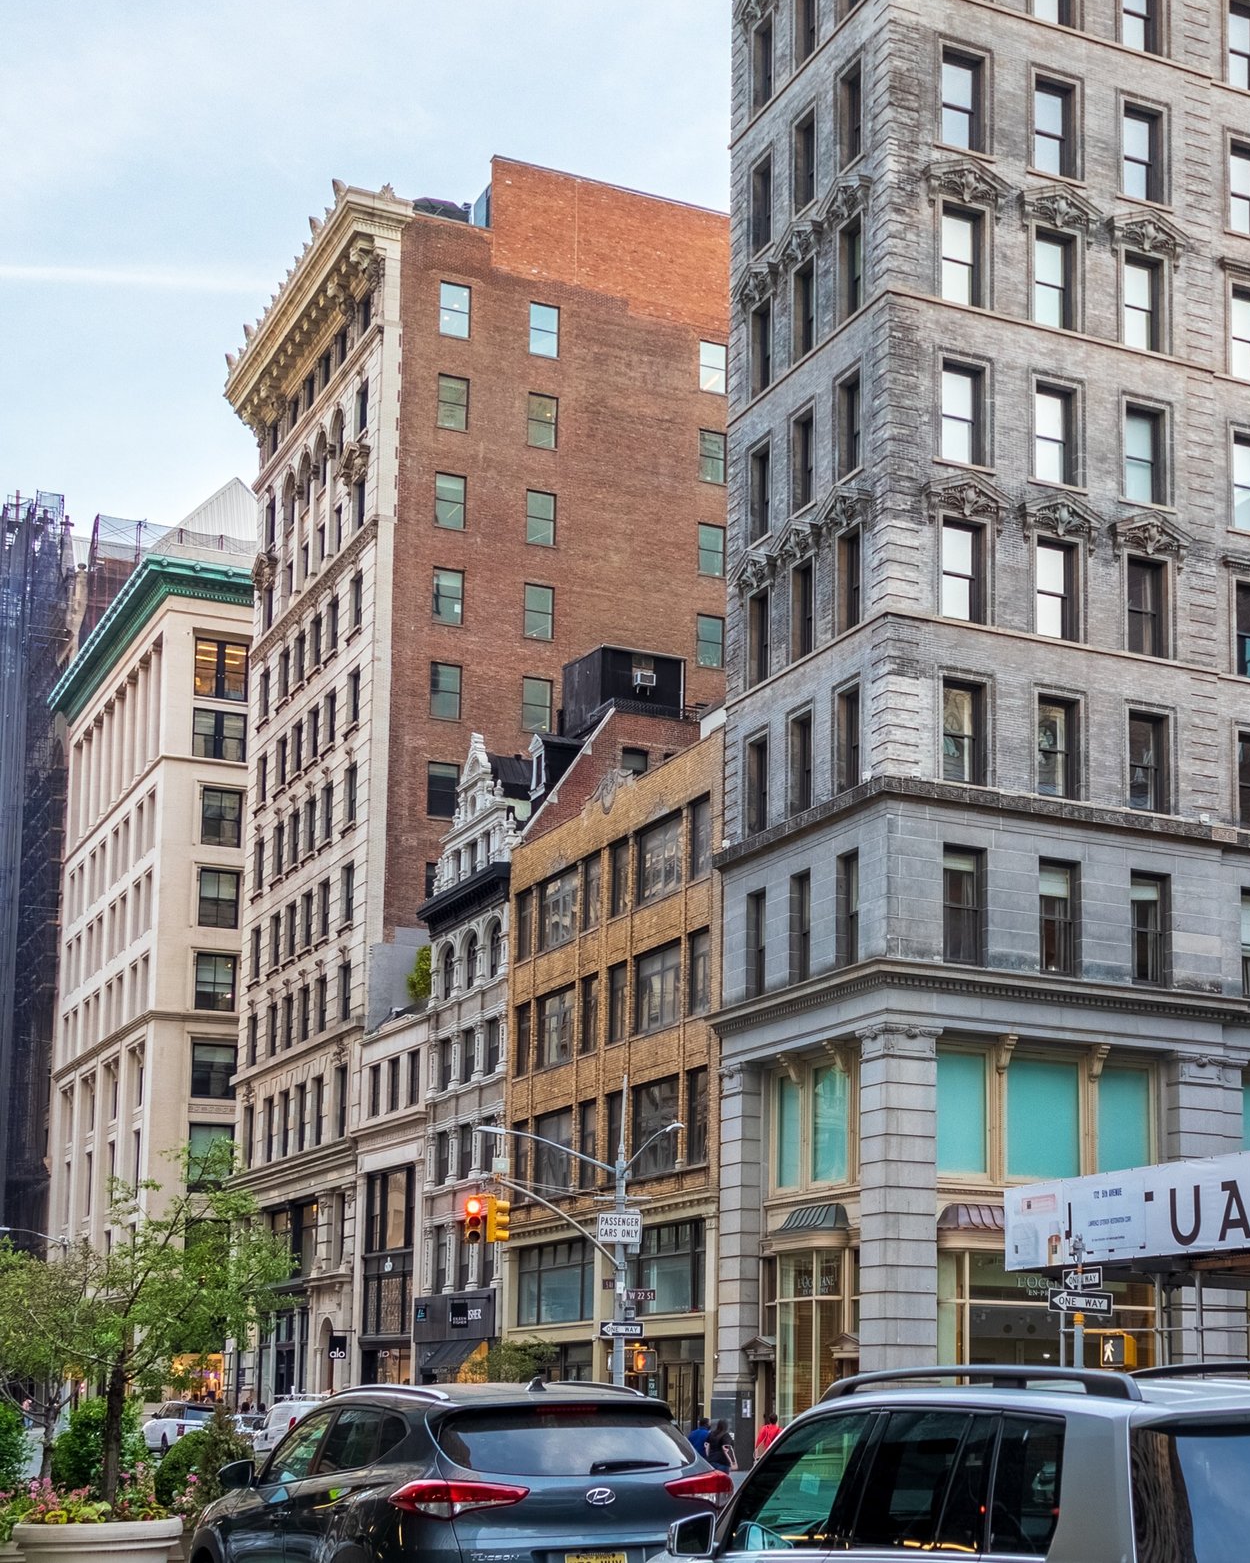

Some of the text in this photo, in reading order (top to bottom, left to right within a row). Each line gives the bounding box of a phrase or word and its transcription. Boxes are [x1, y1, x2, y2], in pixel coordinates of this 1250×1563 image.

[600, 1216, 639, 1227] PASSENGER
[600, 1228, 639, 1238] CARS ONLY
[1084, 1274, 1097, 1283] WAY
[1059, 1297, 1104, 1308] ONE WAY
[330, 1347, 345, 1358] alo
[470, 1551, 520, 1562] TUCSON
